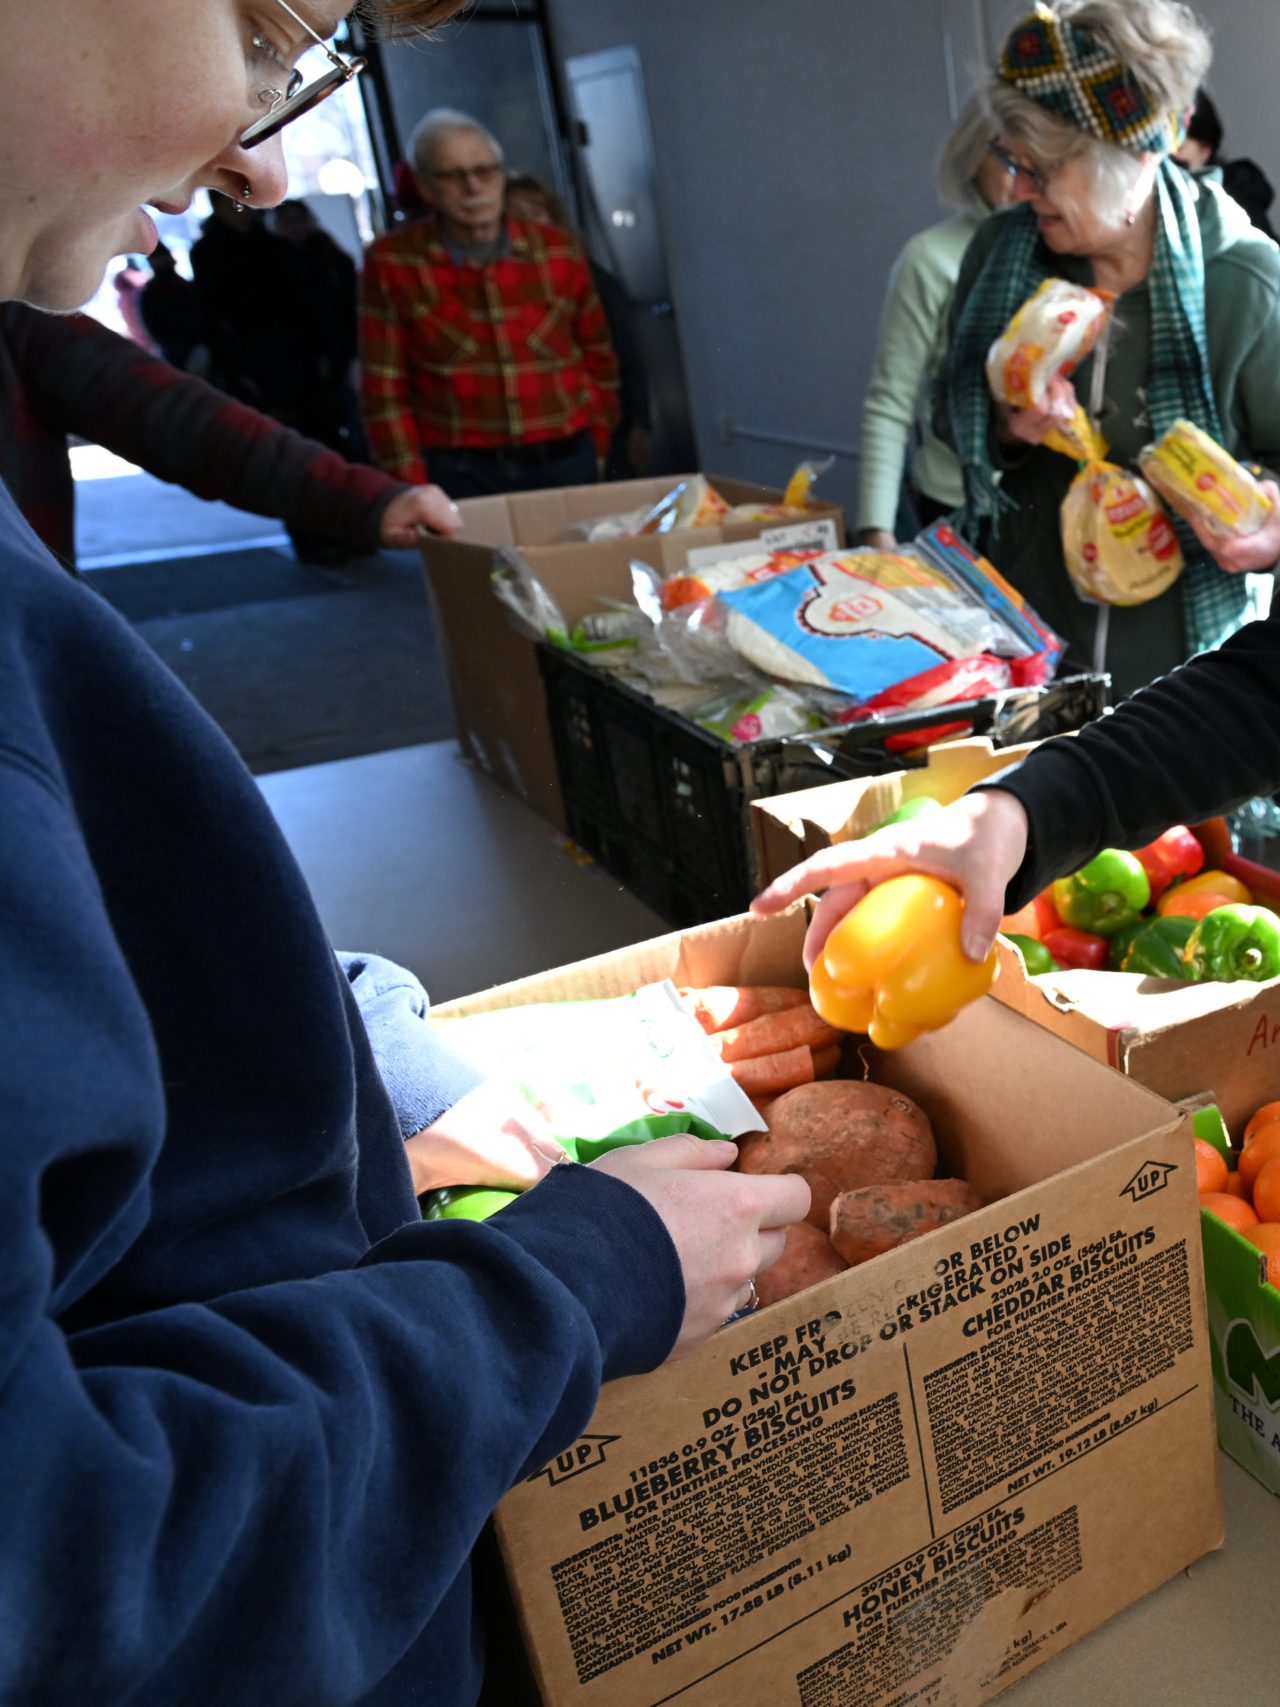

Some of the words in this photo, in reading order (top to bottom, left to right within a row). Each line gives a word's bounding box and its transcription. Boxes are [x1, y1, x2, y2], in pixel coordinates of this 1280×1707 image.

[1138, 1170, 1159, 1192] UP
[730, 1335, 788, 1375] KEEP
[934, 1252, 964, 1276] OR
[970, 1214, 1039, 1260] BELOW
[962, 1274, 1064, 1336] CHEDDAR
[1070, 1226, 1155, 1282] BISCUITS
[987, 1320, 1011, 1339] FOR
[1014, 1292, 1064, 1324] FURTHER
[1067, 1254, 1137, 1297] PROCESSING
[991, 1277, 1029, 1303] 23026
[1032, 1266, 1050, 1283] 2.0
[1053, 1255, 1074, 1271] OZ.
[1078, 1237, 1106, 1261] (56g)
[1109, 1230, 1127, 1243] EA.
[703, 1398, 742, 1428] DO
[749, 1366, 800, 1405] NOT
[880, 1314, 912, 1340] OR
[919, 1277, 984, 1322] STACK
[990, 1257, 1023, 1285] ON
[1030, 1234, 1071, 1267] SIDE
[775, 1334, 825, 1375] MAY
[557, 1444, 592, 1472] UP
[579, 1437, 735, 1531] BLUEBERRY
[744, 1379, 856, 1449] BISCUITS
[629, 1451, 679, 1482] 11836
[682, 1437, 706, 1456] 0.9
[711, 1423, 739, 1442] OZ.
[742, 1400, 780, 1429] (25g)
[784, 1391, 807, 1407] EA.
[1008, 1473, 1030, 1493] NET
[1032, 1460, 1055, 1477] WT.
[1059, 1438, 1090, 1462] 19.12
[1093, 1428, 1106, 1442] LB
[1110, 1409, 1137, 1436] (8.67
[1140, 1398, 1158, 1415] kg)
[1231, 1396, 1265, 1438] THE
[624, 1500, 658, 1524] FOR
[661, 1465, 728, 1505] FURTHER
[731, 1416, 823, 1470] PROCESSING
[843, 1564, 925, 1627] HONEY
[933, 1507, 1024, 1573] BISCUITS
[856, 1611, 882, 1633] FOR
[886, 1577, 939, 1615] FURTHER
[942, 1530, 1017, 1580] PROCESSING
[861, 1567, 901, 1597] 39733
[904, 1554, 924, 1571] 0.9
[927, 1540, 949, 1557] OZ.
[953, 1518, 983, 1544] (25g)
[987, 1508, 1005, 1523] EA.
[651, 1638, 682, 1664] NET
[684, 1622, 717, 1644] WT.
[720, 1595, 763, 1625] 17.88
[766, 1584, 784, 1600] LB
[788, 1561, 822, 1590] (8.11
[827, 1544, 851, 1565] kg)
